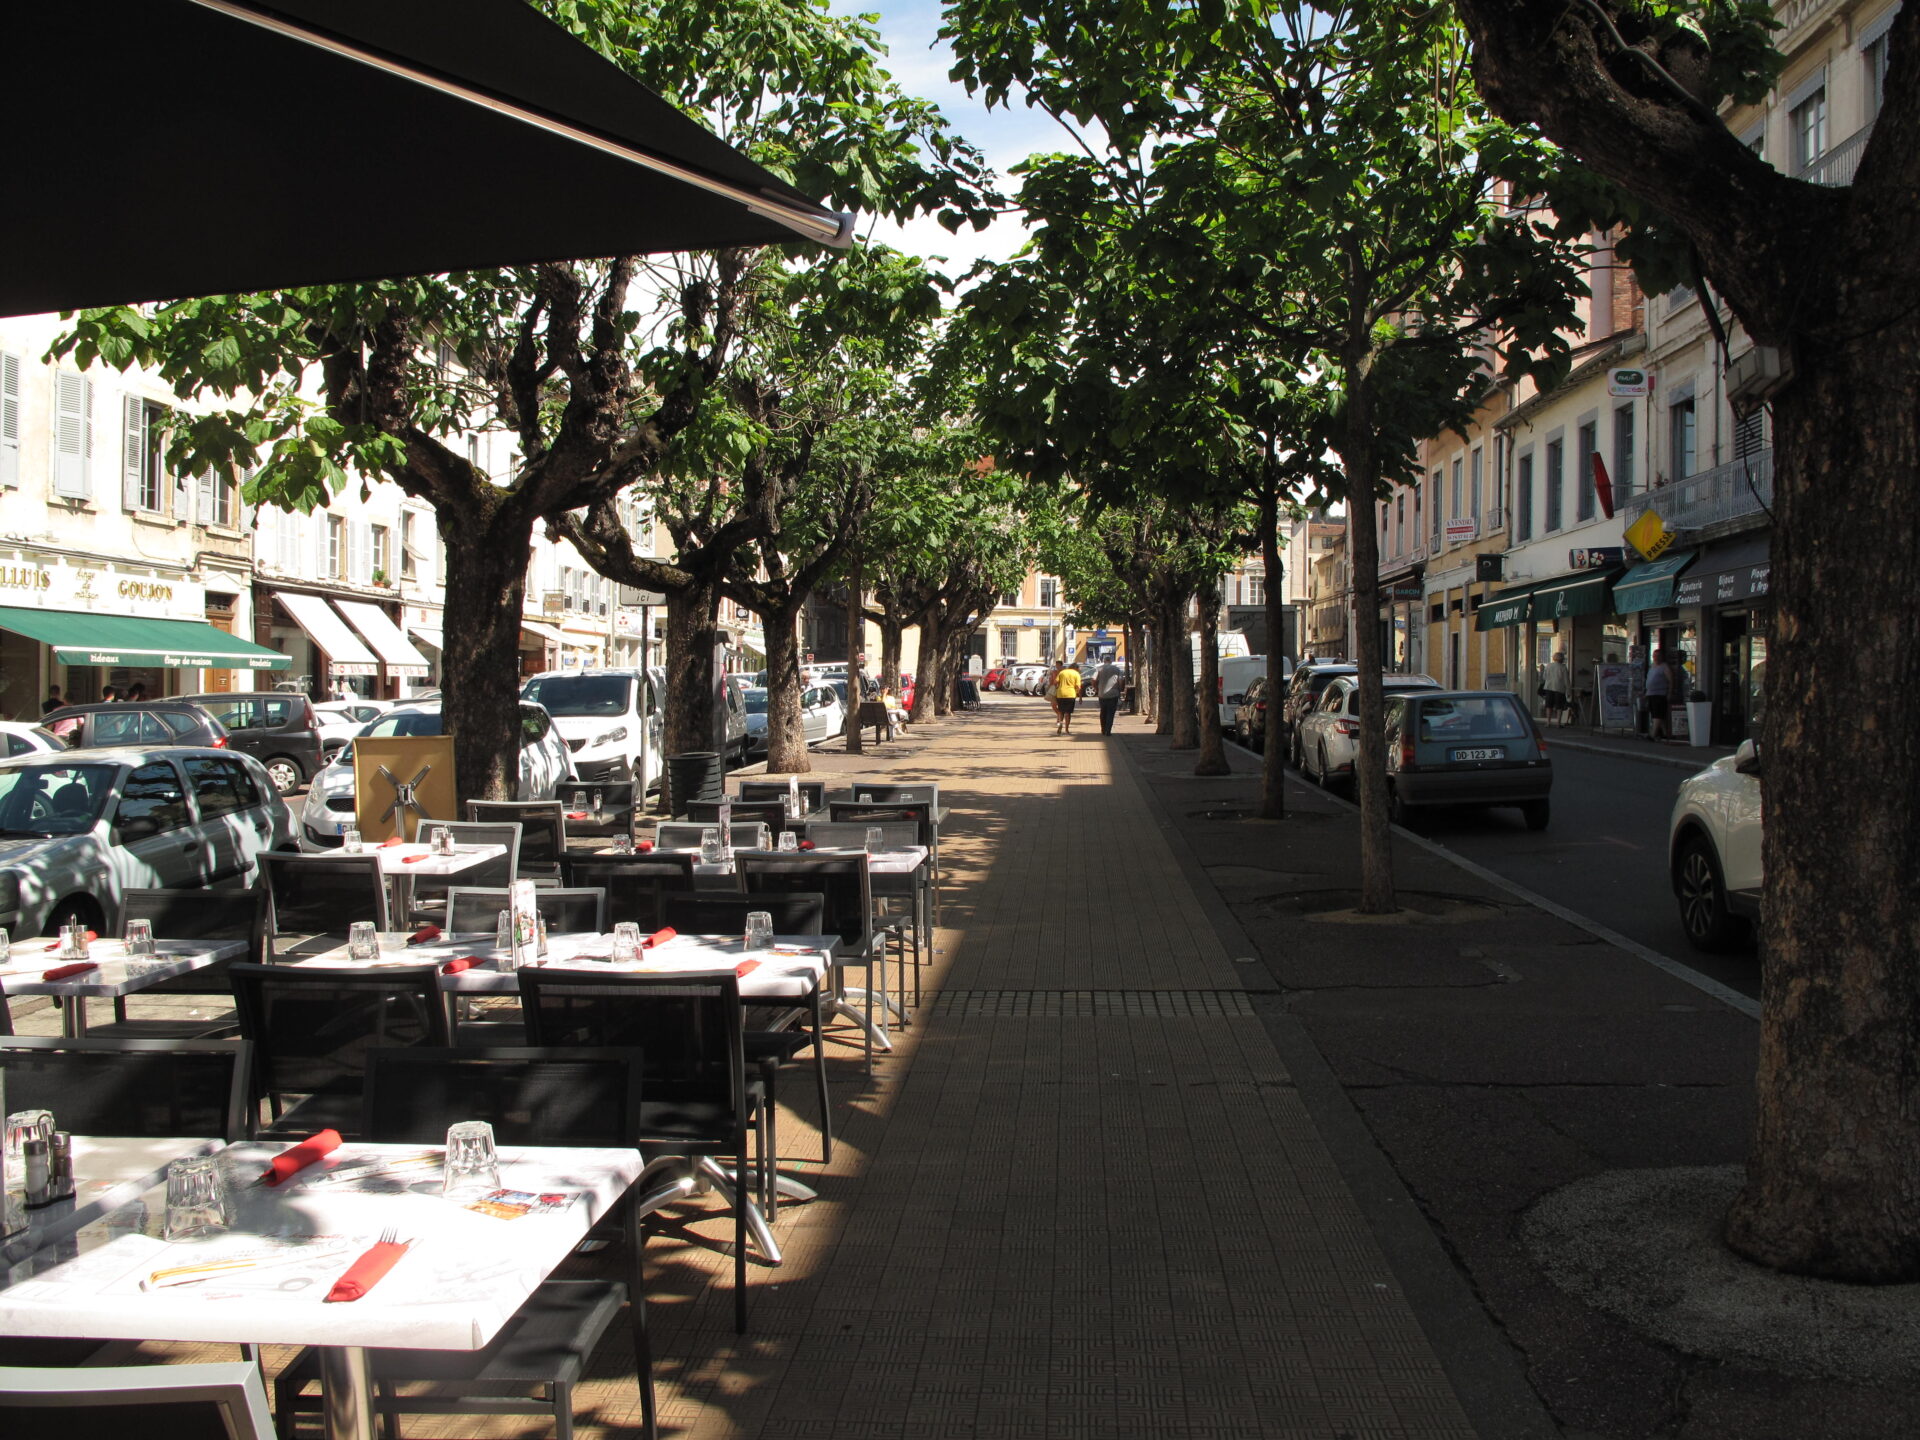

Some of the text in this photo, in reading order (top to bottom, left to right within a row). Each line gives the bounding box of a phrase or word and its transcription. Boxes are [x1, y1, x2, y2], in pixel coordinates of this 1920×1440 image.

[1646, 531, 1673, 557] PRESSE
[118, 580, 173, 600] GOUJON
[636, 593, 650, 602] ici
[164, 654, 212, 667] linge de maison
